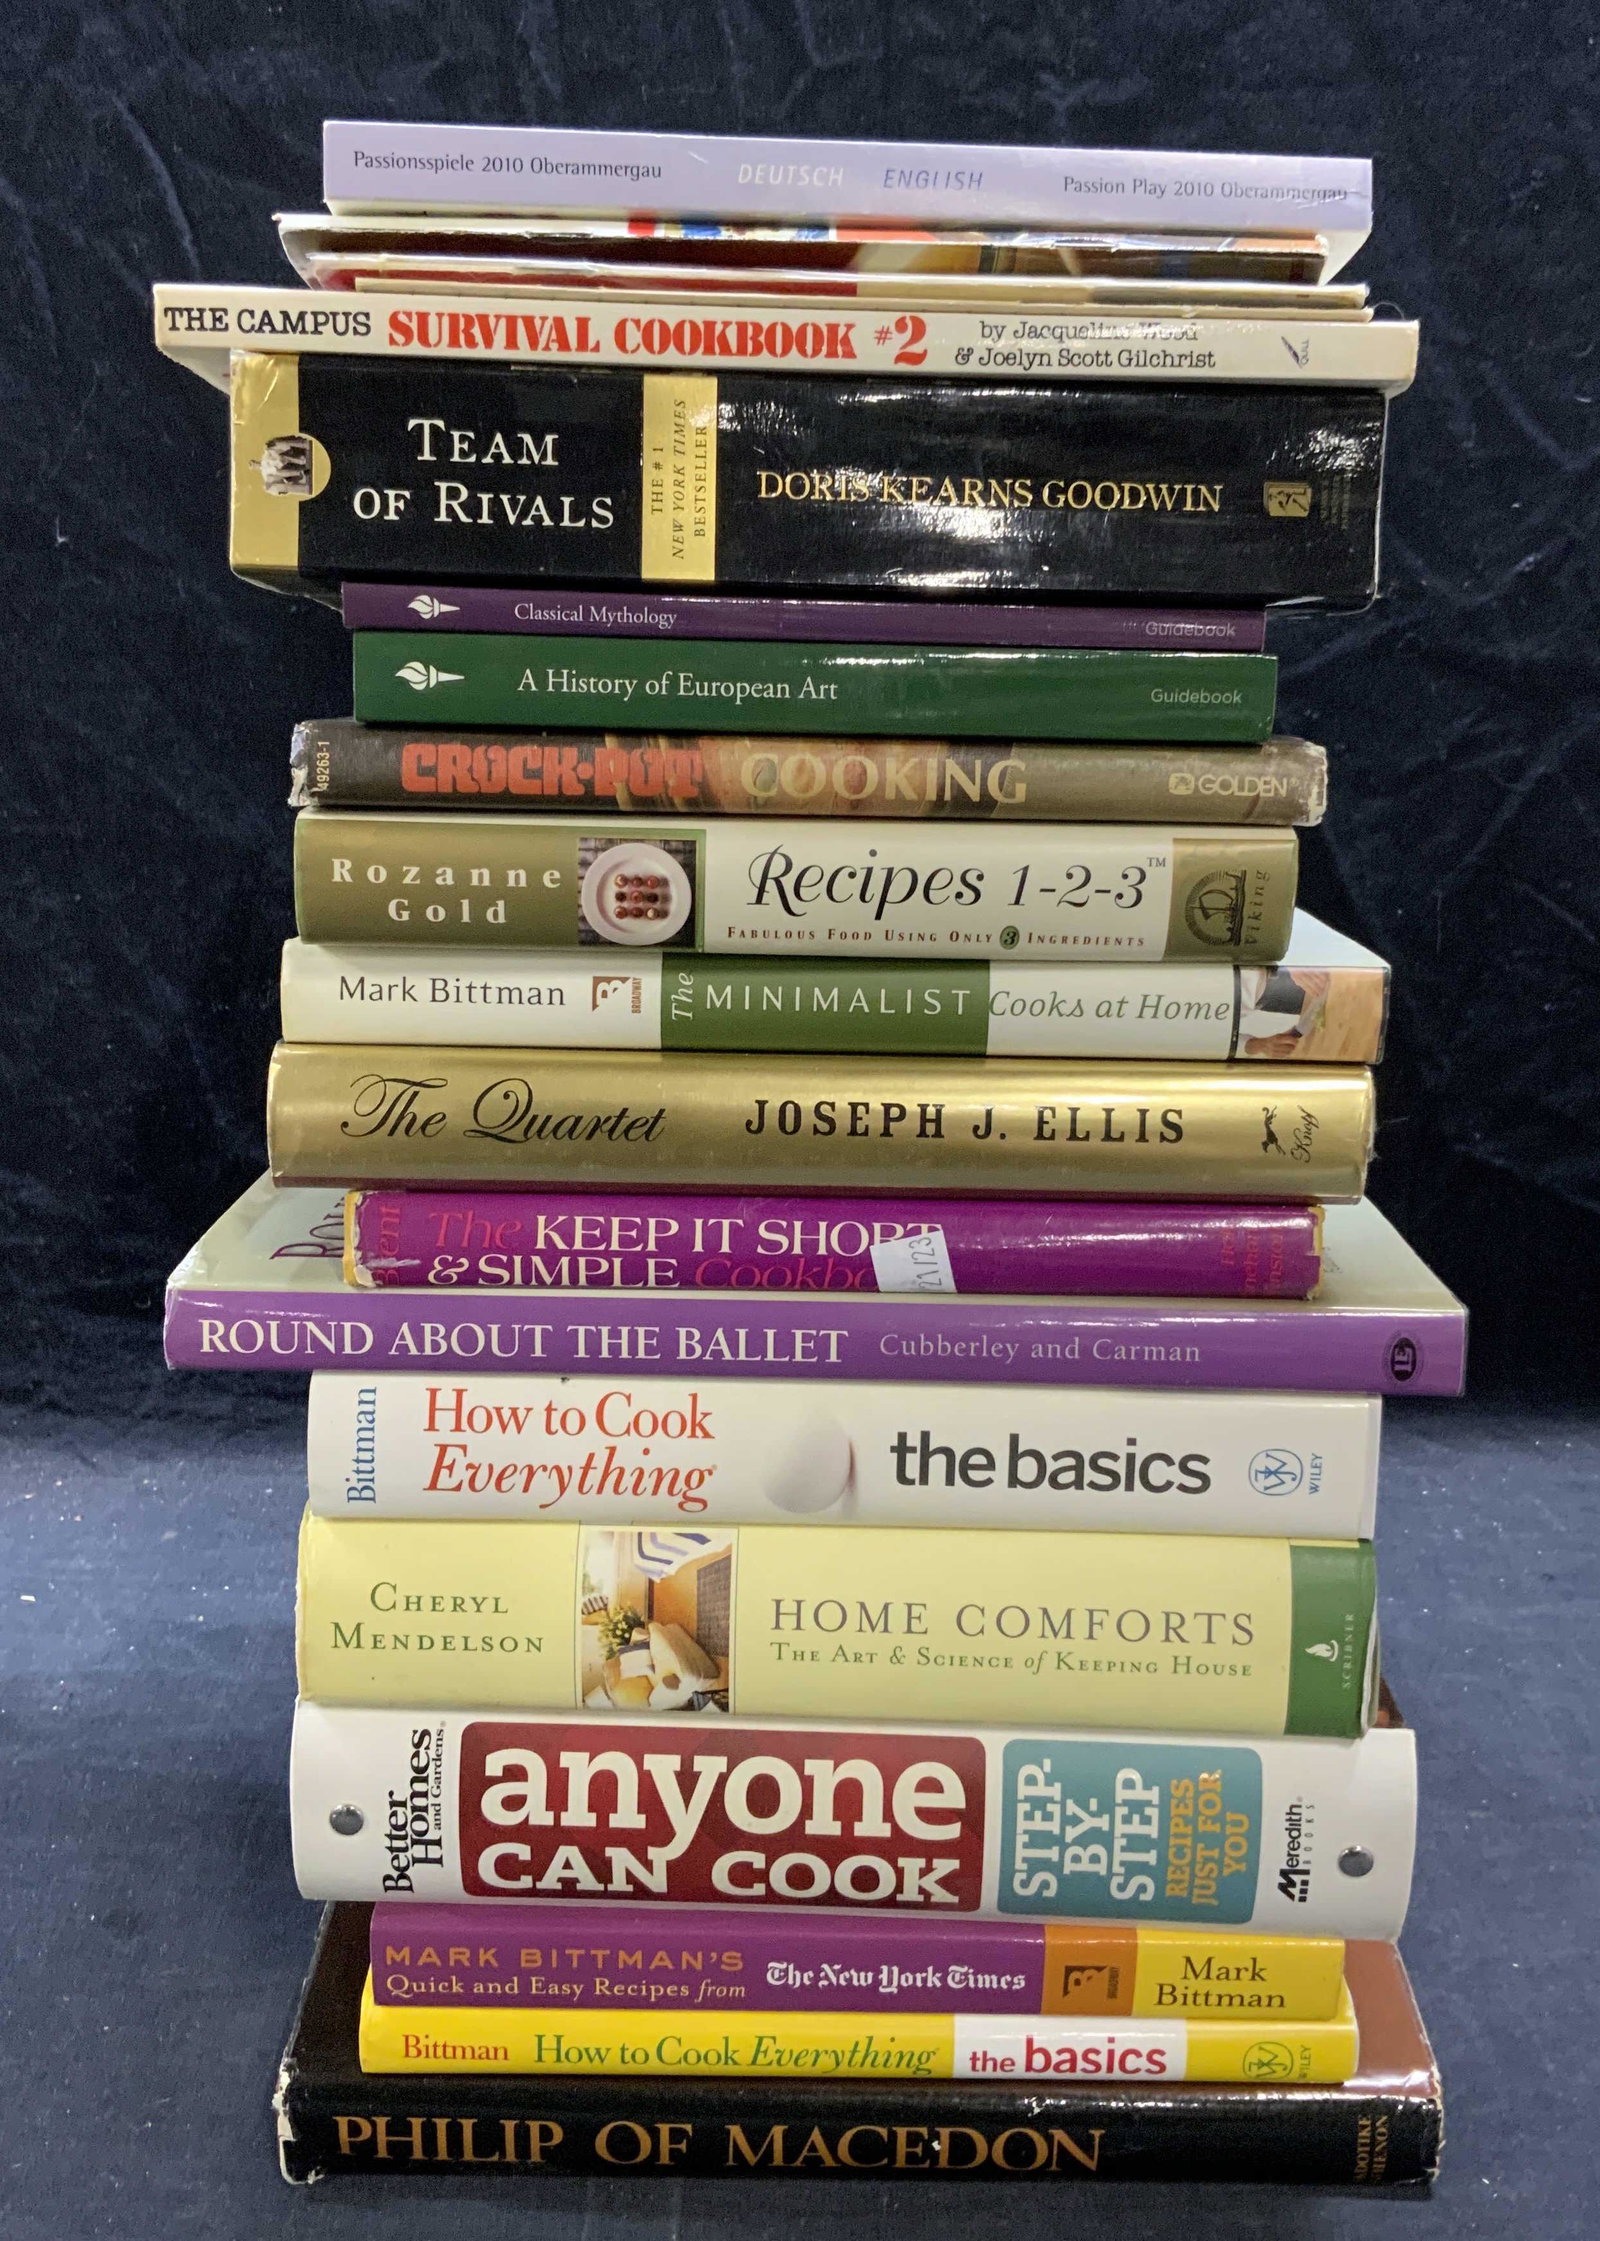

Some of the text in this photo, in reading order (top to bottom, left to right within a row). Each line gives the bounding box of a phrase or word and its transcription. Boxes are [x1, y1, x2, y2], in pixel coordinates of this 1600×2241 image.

[353, 150, 662, 182] Passionsspiele 2010 Oberammergau
[738, 163, 983, 190] DEUTSCH ENGLISH
[1063, 176, 1347, 204] Passion Play 2010 Oberammergau
[165, 307, 928, 366] THE CAMPUS SURVIVAL COOKBOOK #2
[980, 321, 1005, 342] by
[955, 348, 1215, 371] & Joelyn Scott Gilchrist
[408, 419, 559, 466] TEAM
[651, 479, 664, 515] THE
[672, 398, 687, 560] NEW YORK TIMES
[694, 425, 708, 538] BESTSELLER
[758, 472, 1223, 513] DORIS KEARNS GOODWIN
[434, 481, 614, 529] RIVALS
[514, 604, 678, 629] Classical Mythology
[1145, 620, 1236, 638] Guidebook
[518, 669, 838, 705] A History of European Art
[1151, 688, 1242, 705] Guidebook
[740, 751, 1026, 805] COOKING
[332, 858, 562, 889] Rozanne
[747, 844, 983, 921] Recipes
[388, 899, 507, 924] Gold
[1244, 870, 1270, 946] Viking
[727, 925, 1145, 948] FABULOUS FOOD USING ONLY 3 INGREDIENTS
[340, 975, 566, 1006] Mark Bittman
[631, 976, 642, 1014] BROADWAY
[672, 972, 1230, 1023] The MINIMALIST Cooks at Home
[340, 1073, 666, 1144] The Quartet
[745, 1099, 1186, 1144] JOSEPH J. ELLIS
[1290, 1103, 1321, 1164] Knopf
[428, 1211, 521, 1249] The
[535, 1215, 680, 1252] KEEP
[692, 1218, 745, 1253] IT
[429, 1255, 470, 1285] &
[478, 1257, 679, 1288] SIMPLE
[199, 1320, 1201, 1365] ROUND ABOUT THE BALLET Cubberley and Carman
[424, 1387, 715, 1439] How to Cook
[347, 1386, 378, 1504] Bittman
[890, 1430, 1212, 1496] the basics
[1308, 1452, 1323, 1495] WILEY
[370, 1582, 509, 1615] CHERYL
[331, 1621, 544, 1654] MENDELSON
[770, 1598, 1254, 1646] HOME COMFORTS
[770, 1642, 1253, 1677] THE ART & SCIENCE of KEEPING HOUSE
[1341, 1612, 1355, 1689] SCRIBNER
[410, 1729, 445, 1869] Homes
[430, 1803, 442, 1831] and
[481, 1747, 966, 1862] anyone
[383, 1790, 415, 1894] Better
[1110, 1767, 1159, 1901] STEP
[1166, 1777, 1194, 1898] RECIPES
[1192, 1768, 1222, 1905] JUST FOR
[1223, 1812, 1250, 1877] YOU
[1303, 1803, 1316, 1866] BOOKS
[478, 1843, 960, 1904] CAN COOK
[386, 1945, 744, 1972] MARK BITTMAN'S
[766, 1961, 1026, 1994] The New York Times
[1181, 1955, 1266, 1983] Mark
[386, 1975, 746, 2003] Quick and Easy Recipes from
[1157, 1981, 1286, 2010] Bittman
[402, 2034, 1168, 2076] Bittman How to Cook Everything the basics
[332, 2115, 1106, 2172] PHILIP OF MACEDON
